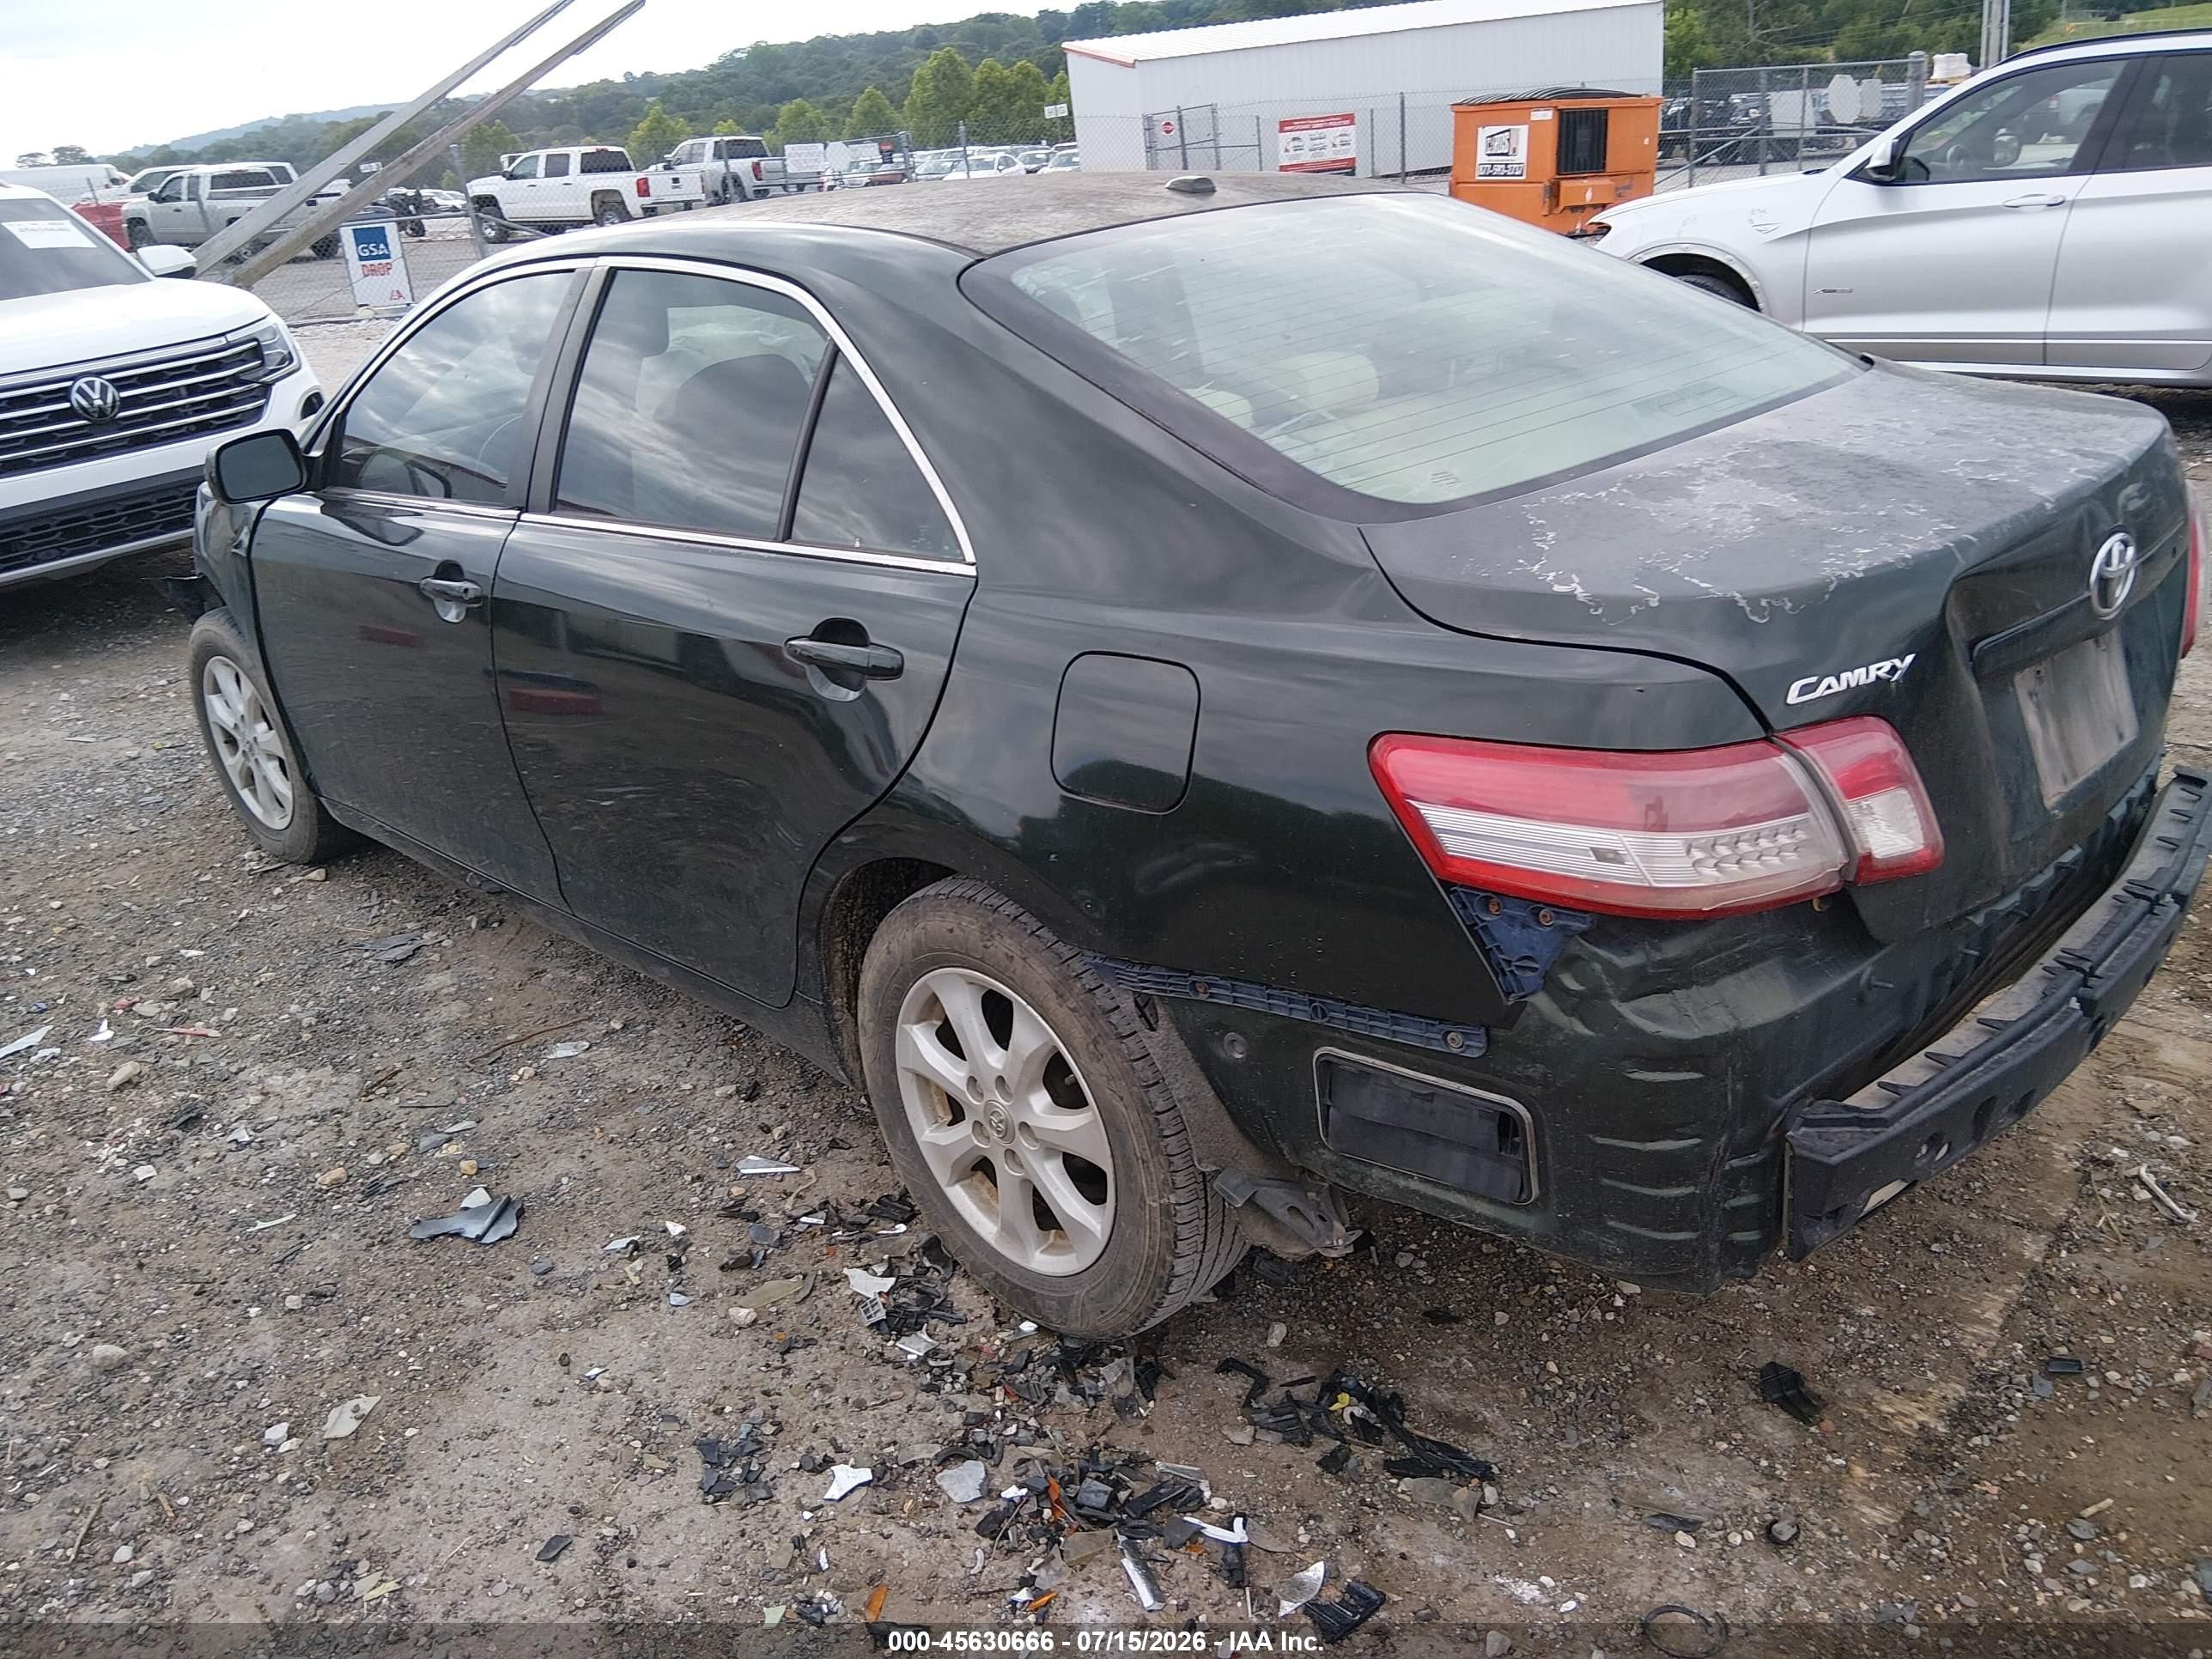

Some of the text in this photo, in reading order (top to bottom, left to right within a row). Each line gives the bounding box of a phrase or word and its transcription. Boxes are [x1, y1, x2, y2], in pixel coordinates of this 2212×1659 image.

[357, 243, 390, 257] GSA
[362, 263, 392, 276] DROP
[1786, 653, 1917, 705] CAMRY
